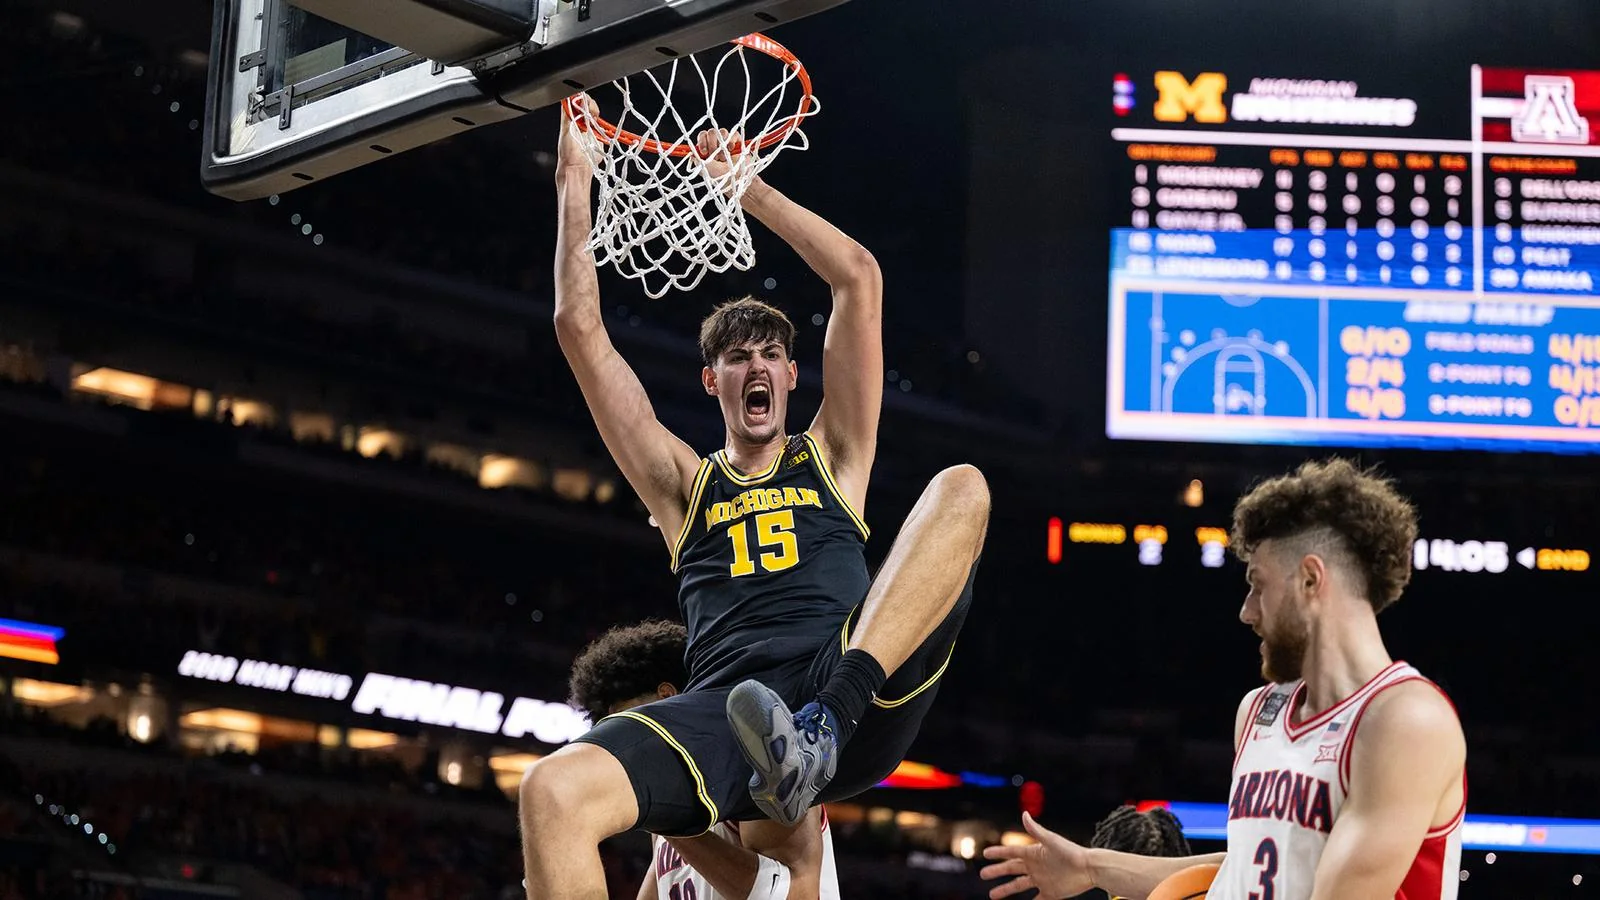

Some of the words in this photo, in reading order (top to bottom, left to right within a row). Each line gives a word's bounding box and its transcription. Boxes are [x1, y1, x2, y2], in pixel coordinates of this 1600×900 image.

[1154, 71, 1228, 123] M
[705, 487, 823, 532] MICHIGAN
[727, 509, 800, 578] 15
[351, 672, 504, 734] FINAL
[1229, 769, 1334, 834] ARIZONA
[1248, 836, 1279, 900] 3
